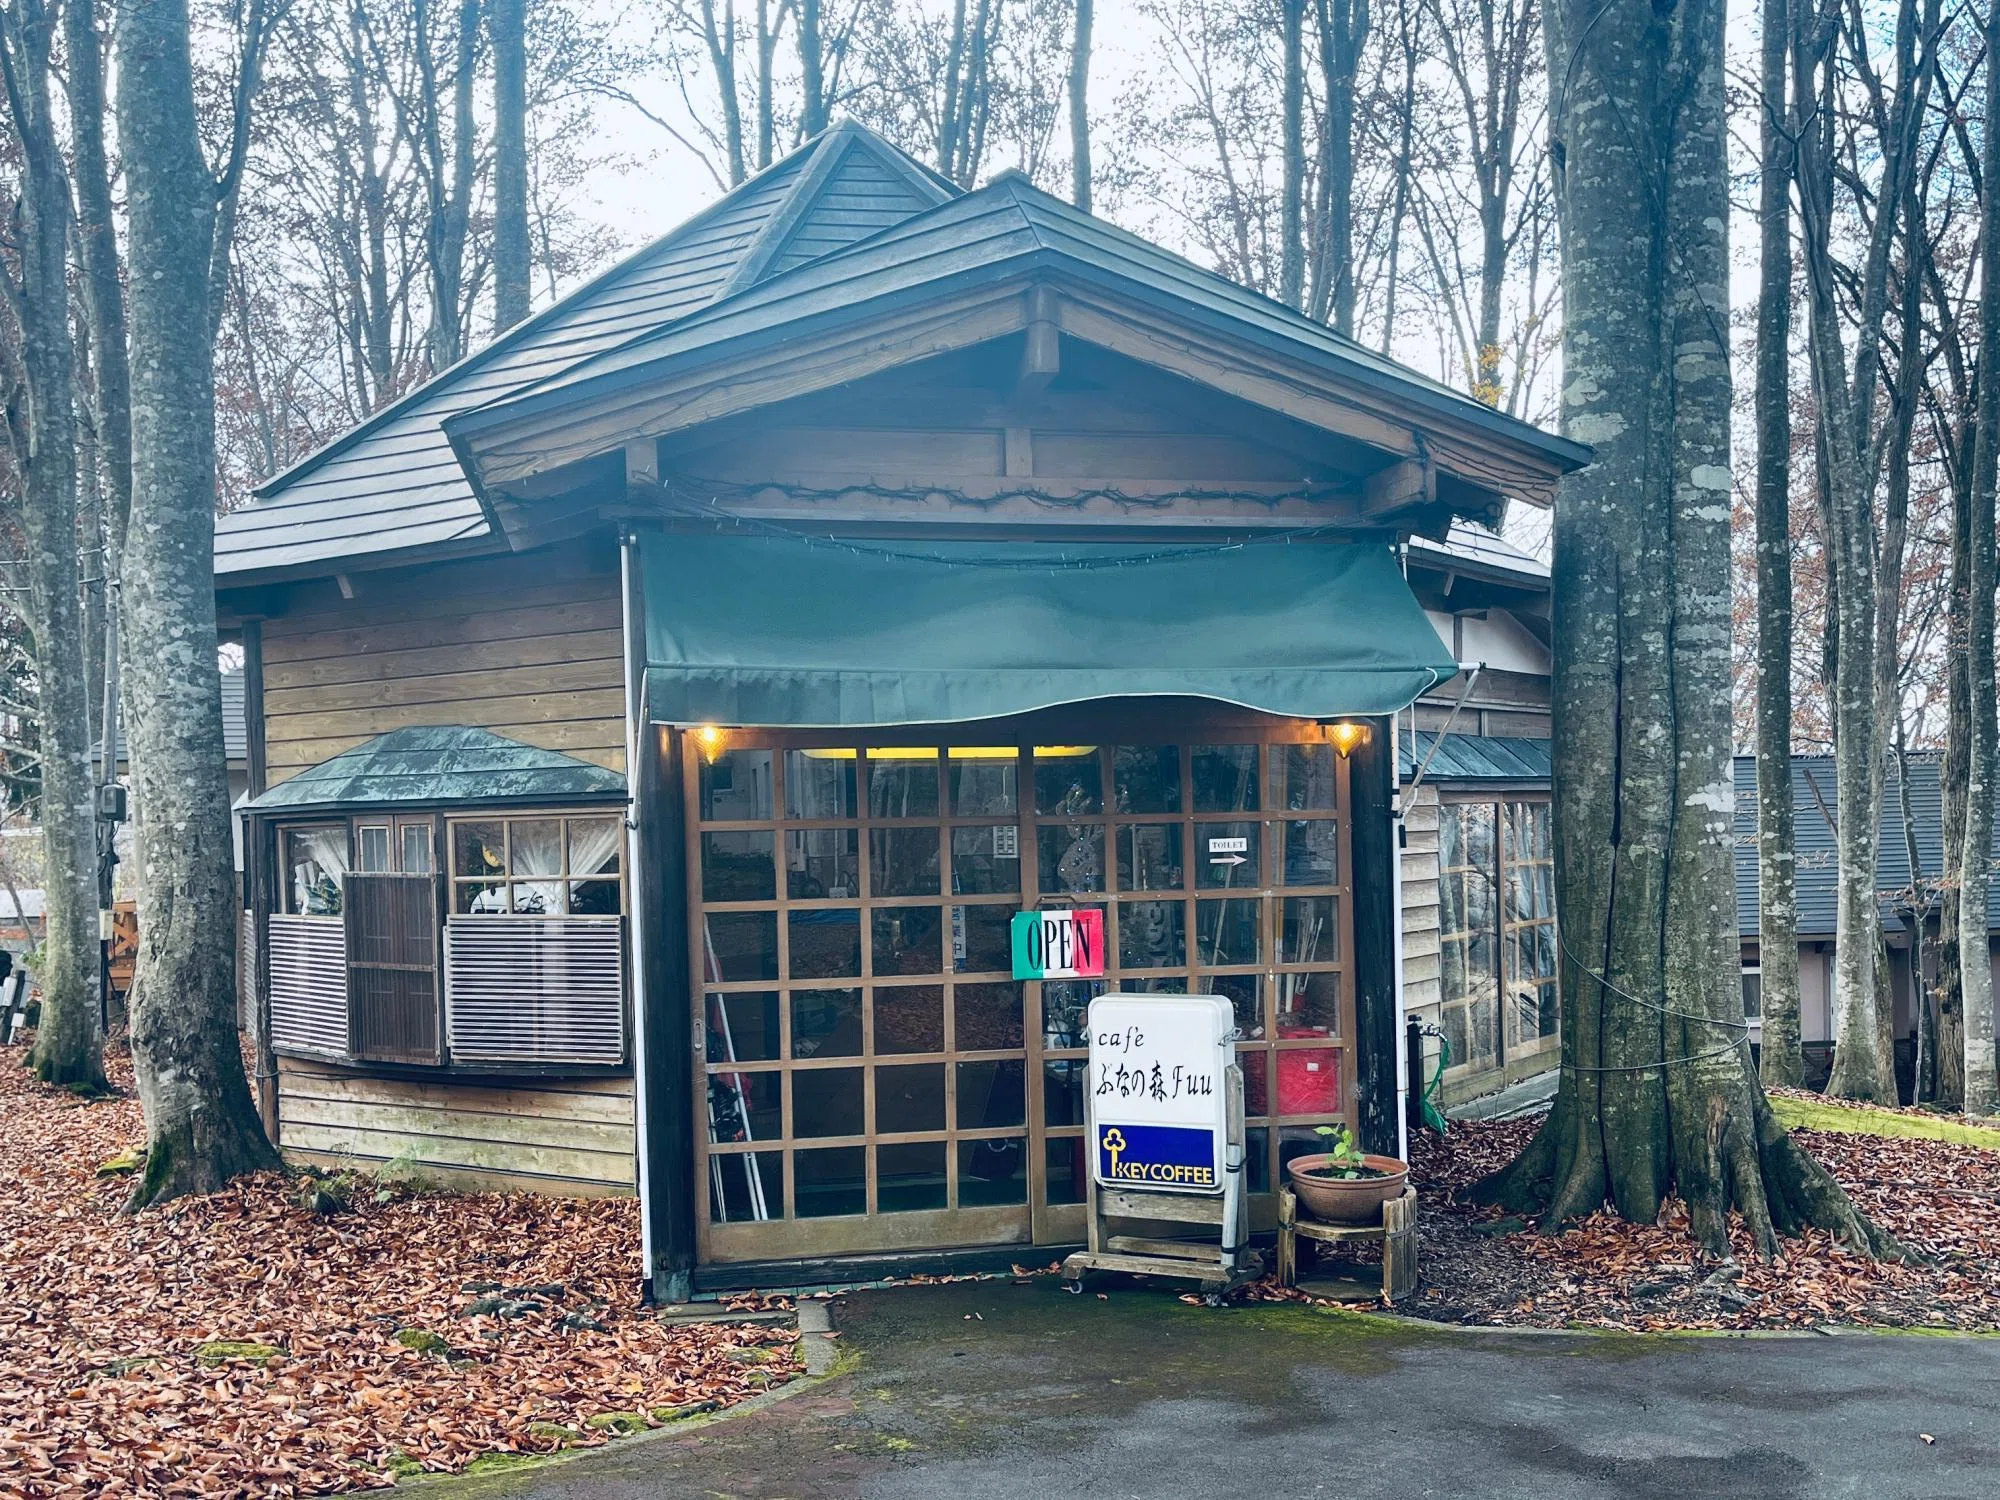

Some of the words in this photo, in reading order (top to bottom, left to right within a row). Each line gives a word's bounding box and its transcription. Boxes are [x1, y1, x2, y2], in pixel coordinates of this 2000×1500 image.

[1212, 841, 1244, 849] TOILET
[1027, 918, 1091, 970] OPEN
[1172, 1065, 1213, 1099] Fuu
[1117, 1162, 1150, 1179] KEY
[1150, 1164, 1213, 1184] COFFEE
